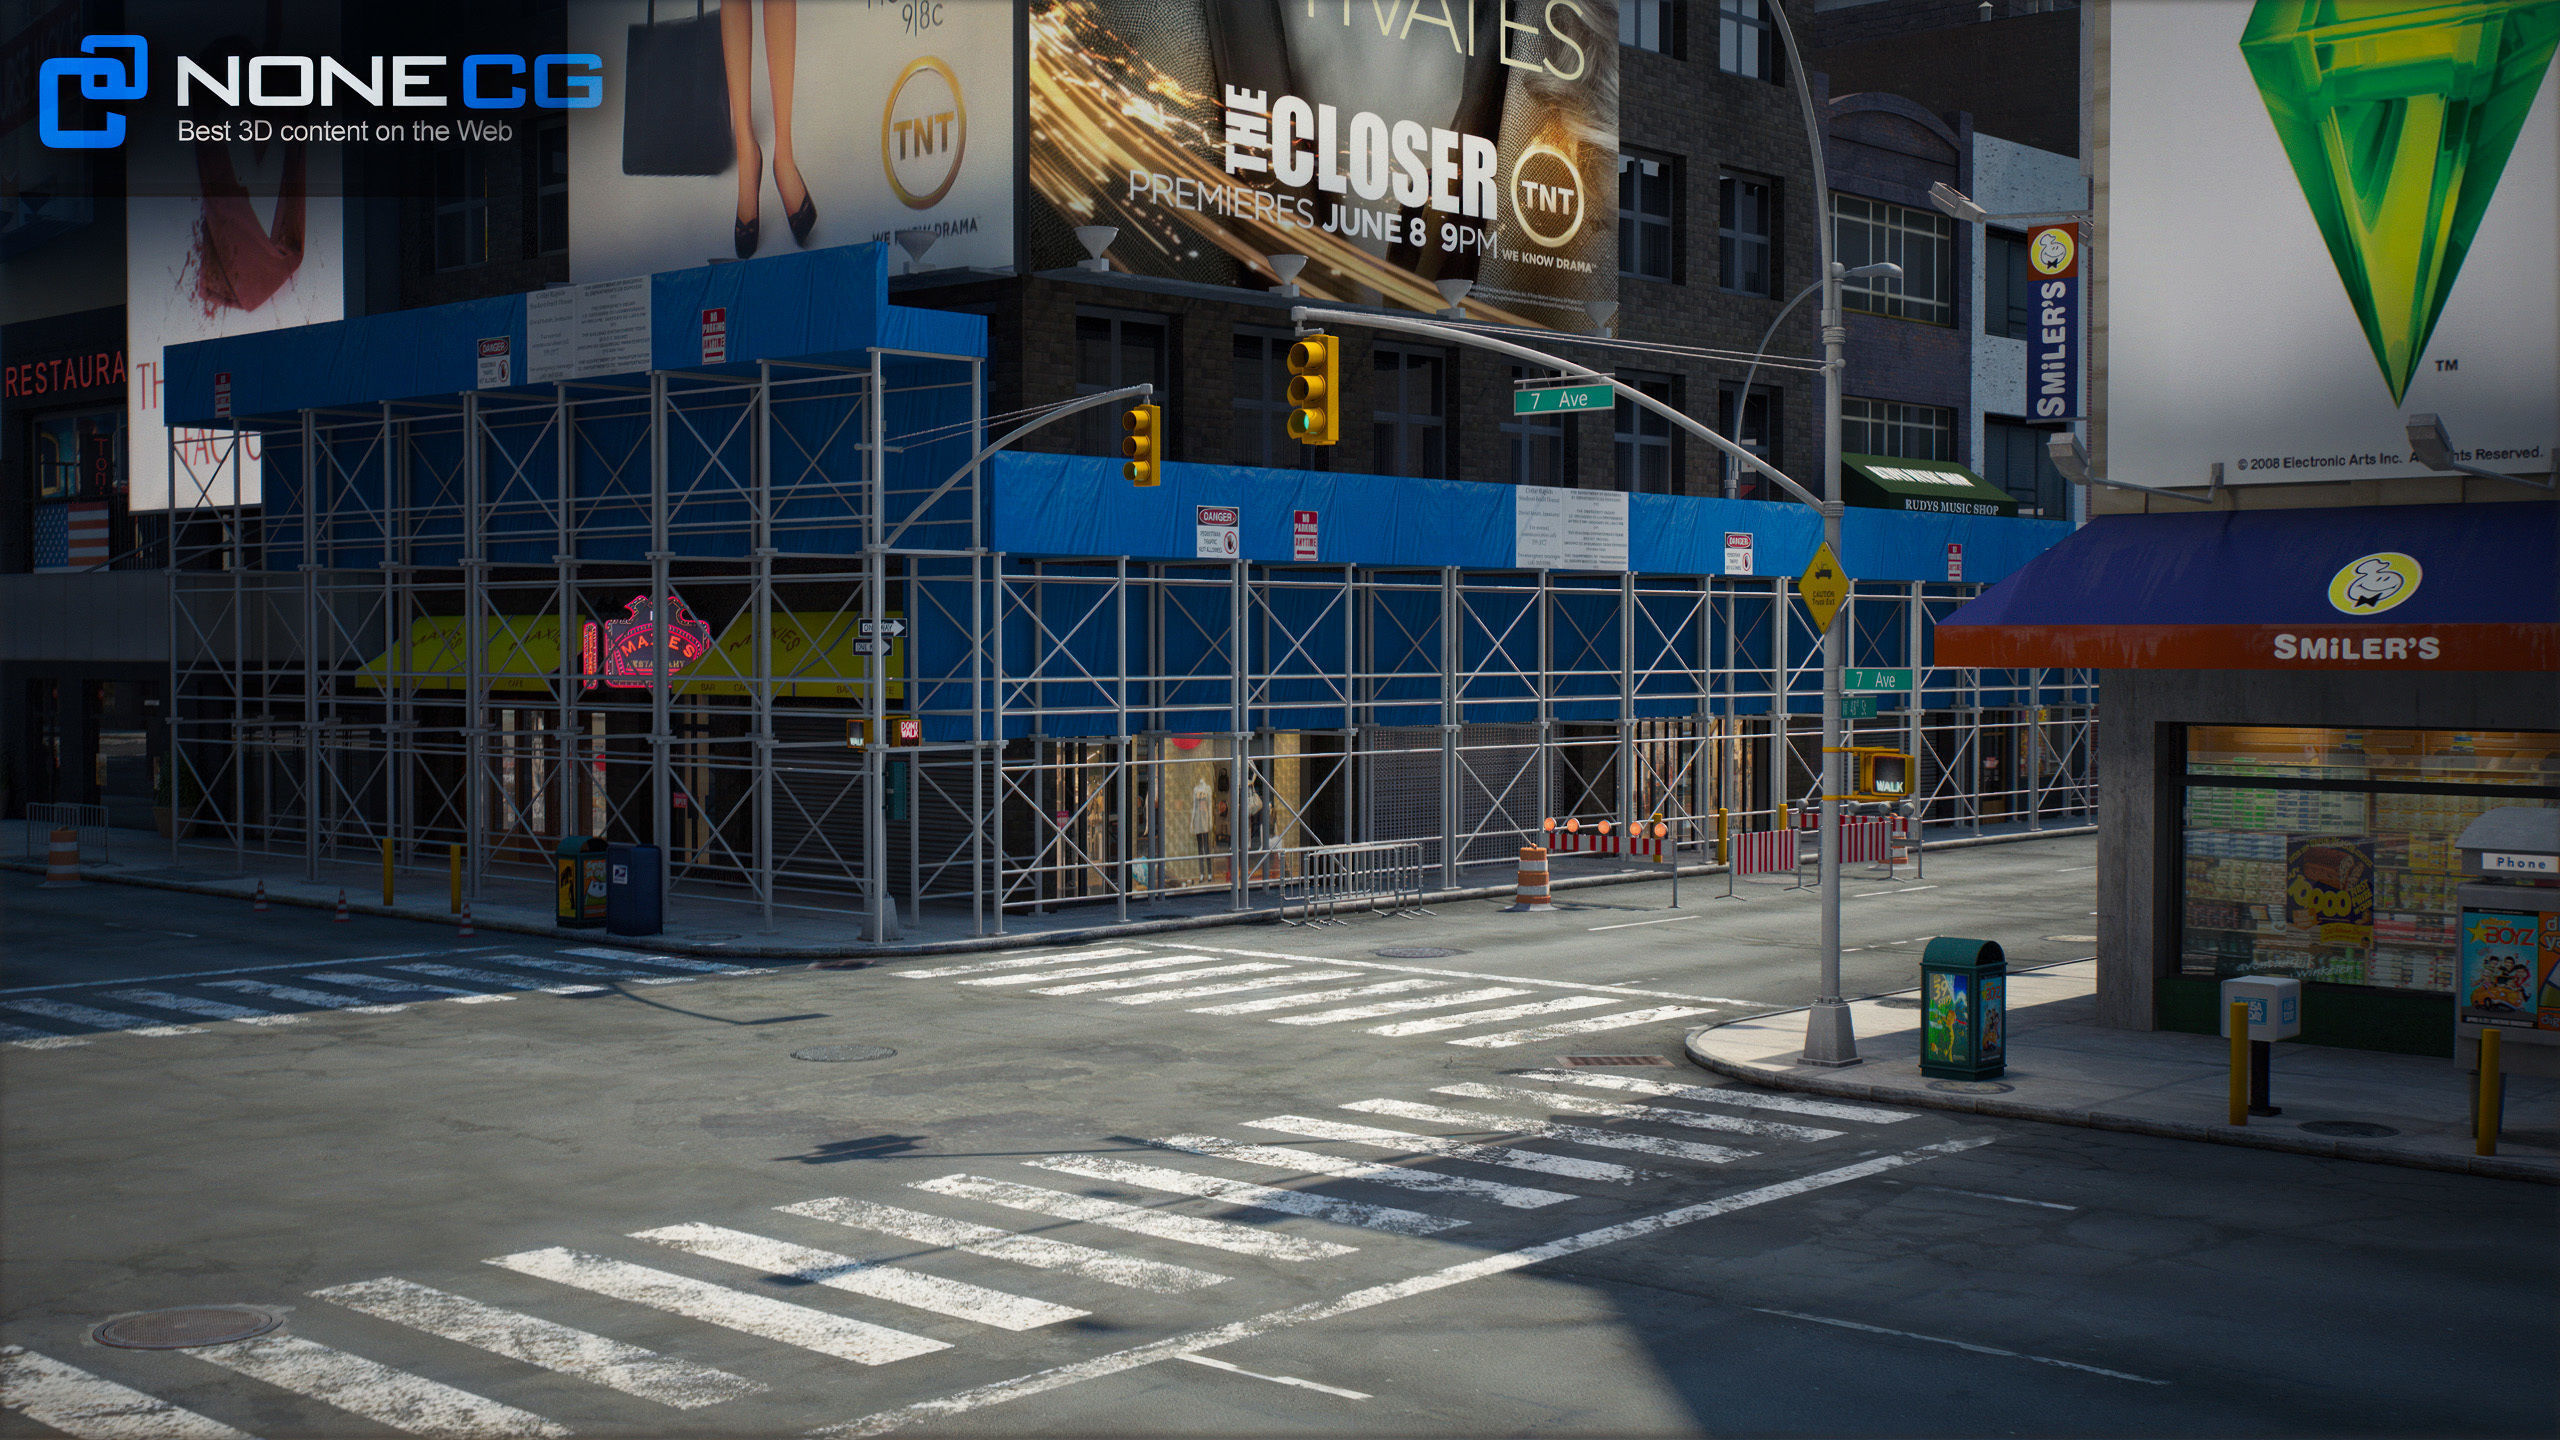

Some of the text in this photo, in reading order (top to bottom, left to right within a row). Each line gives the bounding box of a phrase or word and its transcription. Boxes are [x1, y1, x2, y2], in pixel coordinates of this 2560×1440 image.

[893, 112, 954, 161] TNT
[1225, 84, 1498, 220] THE CLOSER
[1521, 180, 1574, 215] TNT
[1129, 169, 1498, 259] PREMIERES JUNE 8 9PM
[1502, 249, 1519, 262] WE
[1522, 251, 1554, 268] KNOW
[5, 350, 127, 398] RESTAURA
[2435, 360, 2458, 372] TM
[1530, 390, 1588, 410] 7 Ave
[2250, 457, 2281, 471] 2008
[2284, 454, 2347, 469] Electronic
[2349, 452, 2377, 466] Arts
[2379, 451, 2403, 466] Inc.
[2475, 446, 2544, 461] Reserved.
[1203, 511, 1232, 522] DANGER
[1905, 498, 2000, 516] RUDYS MUSIC SHOP
[1856, 671, 1896, 688] 7 Ave
[1875, 779, 1904, 793] WALK
[2497, 857, 2546, 870] Phone
[2486, 926, 2536, 947] BOYZ
